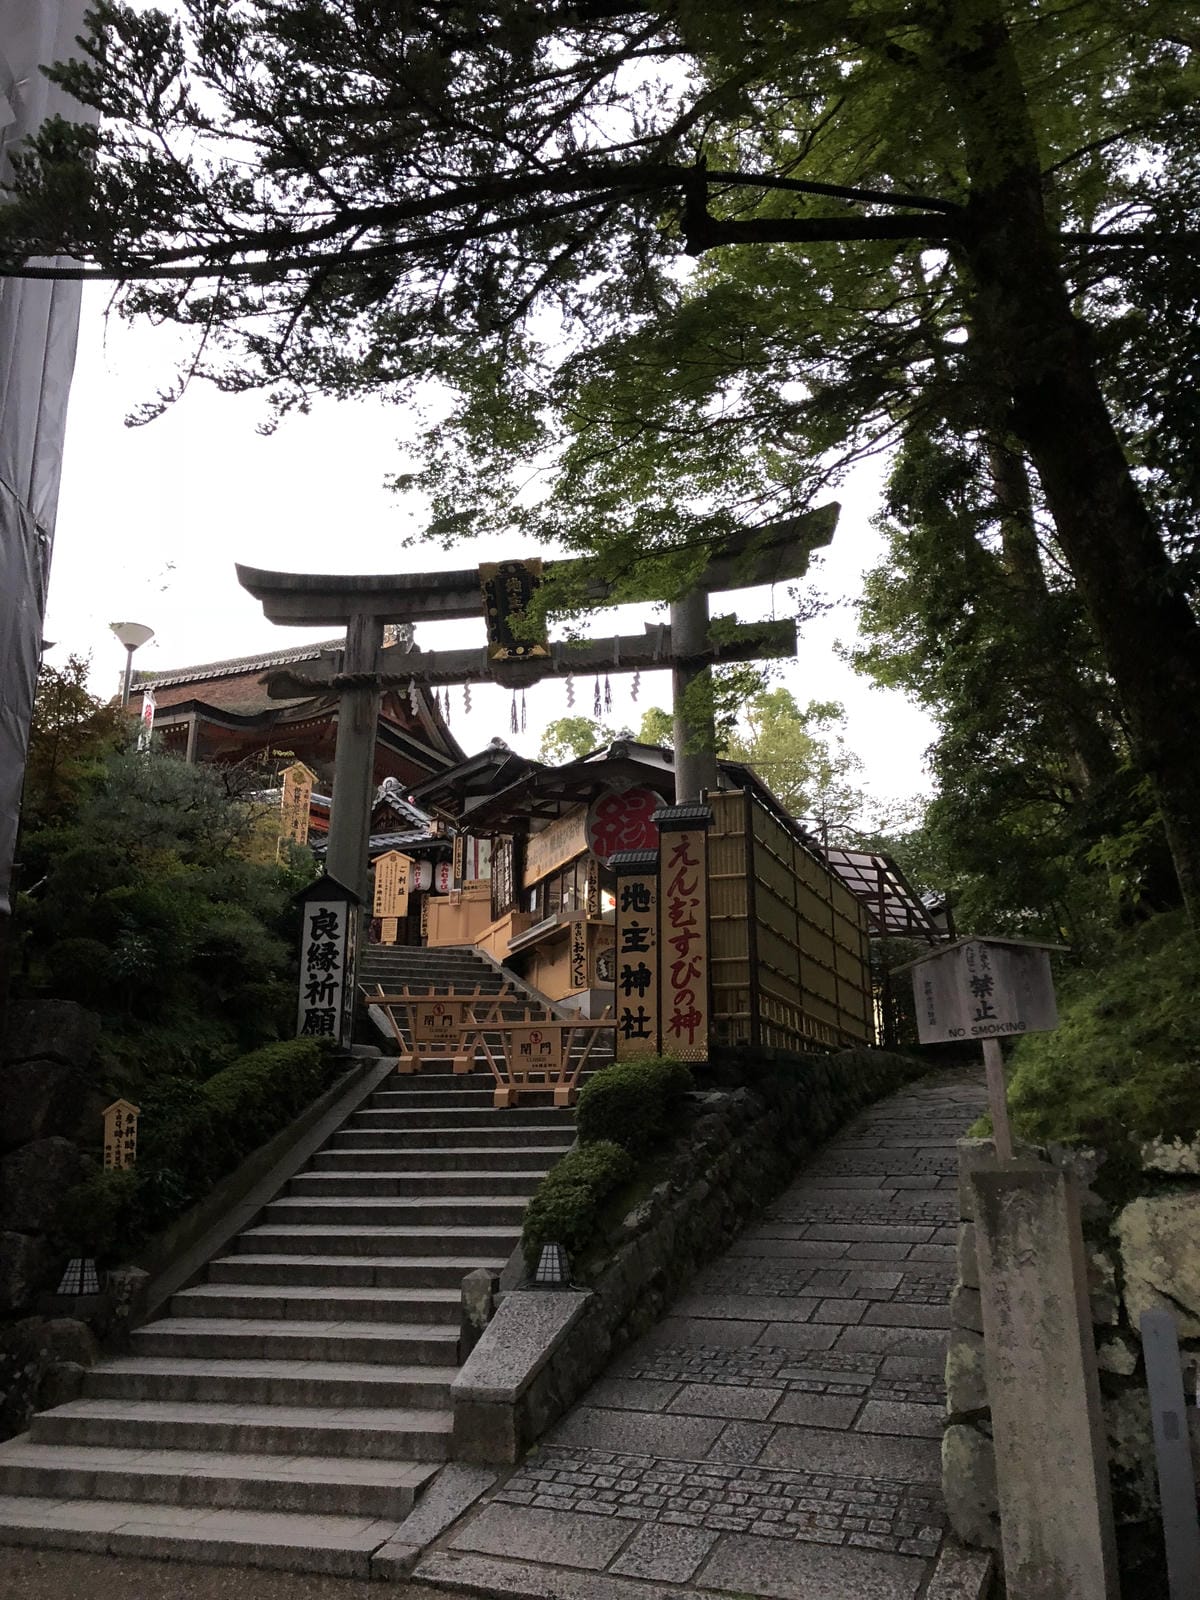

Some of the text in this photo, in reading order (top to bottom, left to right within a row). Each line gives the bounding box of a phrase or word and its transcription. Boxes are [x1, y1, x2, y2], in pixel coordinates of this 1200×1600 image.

[303, 907, 341, 1036] 良縁祈願
[619, 882, 652, 1040] 地主神社
[667, 835, 703, 1045] えんむすびの神
[970, 974, 998, 1022] 禁止
[948, 1021, 1027, 1038] NO SMOKING
